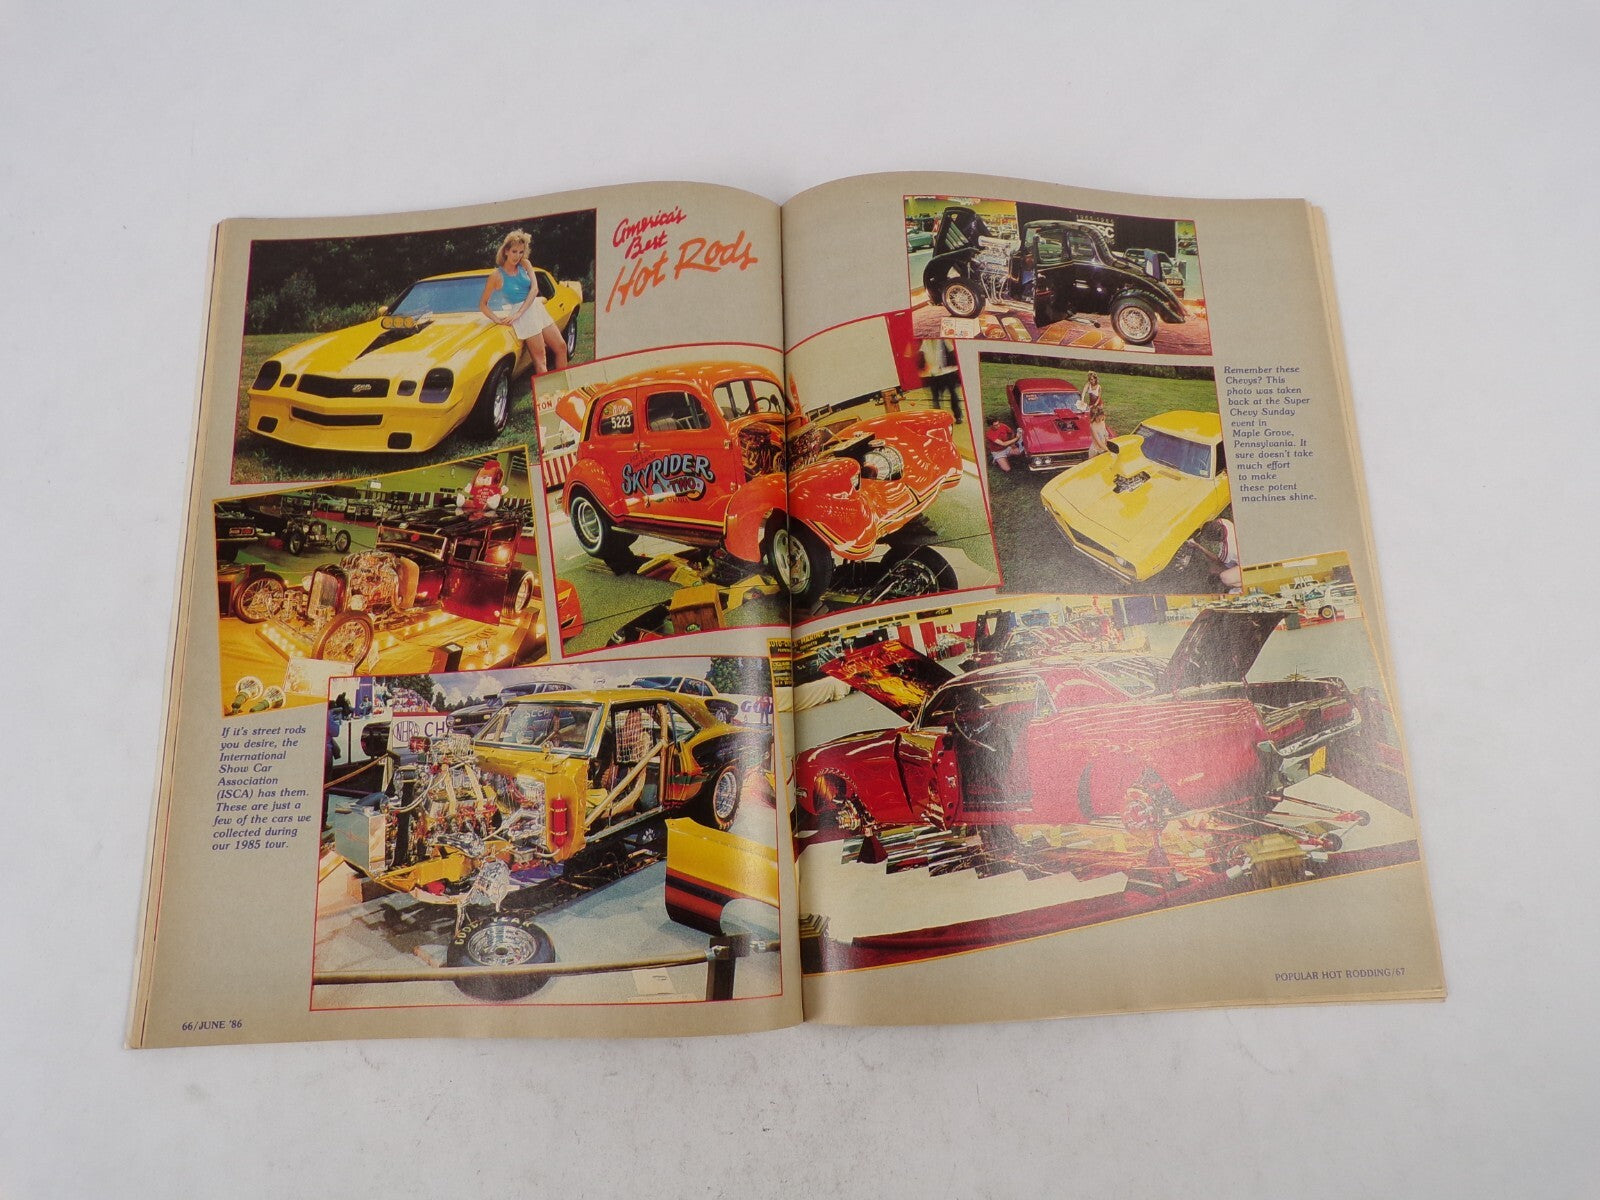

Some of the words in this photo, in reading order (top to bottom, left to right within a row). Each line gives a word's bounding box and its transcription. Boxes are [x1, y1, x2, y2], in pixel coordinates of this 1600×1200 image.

[613, 206, 686, 247] America's
[625, 231, 668, 259] Best
[606, 251, 668, 312] Hot
[674, 230, 758, 280] Rods
[1224, 366, 1272, 374] Remember
[1226, 377, 1262, 385] Chevys?
[1227, 388, 1252, 396] photo
[1284, 397, 1310, 405] Super
[1230, 409, 1257, 417] Chevy
[1262, 408, 1295, 417] Sunday
[611, 415, 631, 429] 5223
[1233, 429, 1260, 438] Maple
[1234, 440, 1296, 449] Pennsylvania.
[1258, 450, 1290, 458] doesn't
[1267, 461, 1290, 470] effort
[622, 454, 715, 496] SKYRIDER
[1252, 472, 1277, 480] make
[1268, 483, 1297, 492] potent
[1242, 494, 1286, 502] machines
[222, 727, 230, 738] If
[233, 727, 248, 736] it's
[252, 727, 281, 735] street
[285, 725, 306, 734] rods
[220, 741, 239, 751] you
[244, 739, 277, 749] desire,
[282, 738, 298, 746] the
[220, 751, 287, 761] International
[219, 765, 248, 773] Show
[253, 763, 272, 772] Car
[218, 777, 278, 786] Association
[217, 789, 253, 800] (ISCA)
[258, 789, 276, 797] has
[280, 788, 309, 797] them.
[217, 802, 247, 811] These
[271, 801, 290, 812] just
[213, 816, 231, 827] few
[237, 815, 248, 826] of
[251, 815, 268, 823] the
[272, 815, 293, 823] cars
[213, 828, 261, 838] collected
[265, 827, 297, 837] during
[235, 840, 260, 849] 1985
[1275, 971, 1318, 981] POPULAR
[1322, 971, 1342, 979] HOT
[1346, 968, 1405, 978] RODDING/67
[182, 1021, 225, 1031] 66/JUNE
[229, 1020, 242, 1028] '86
